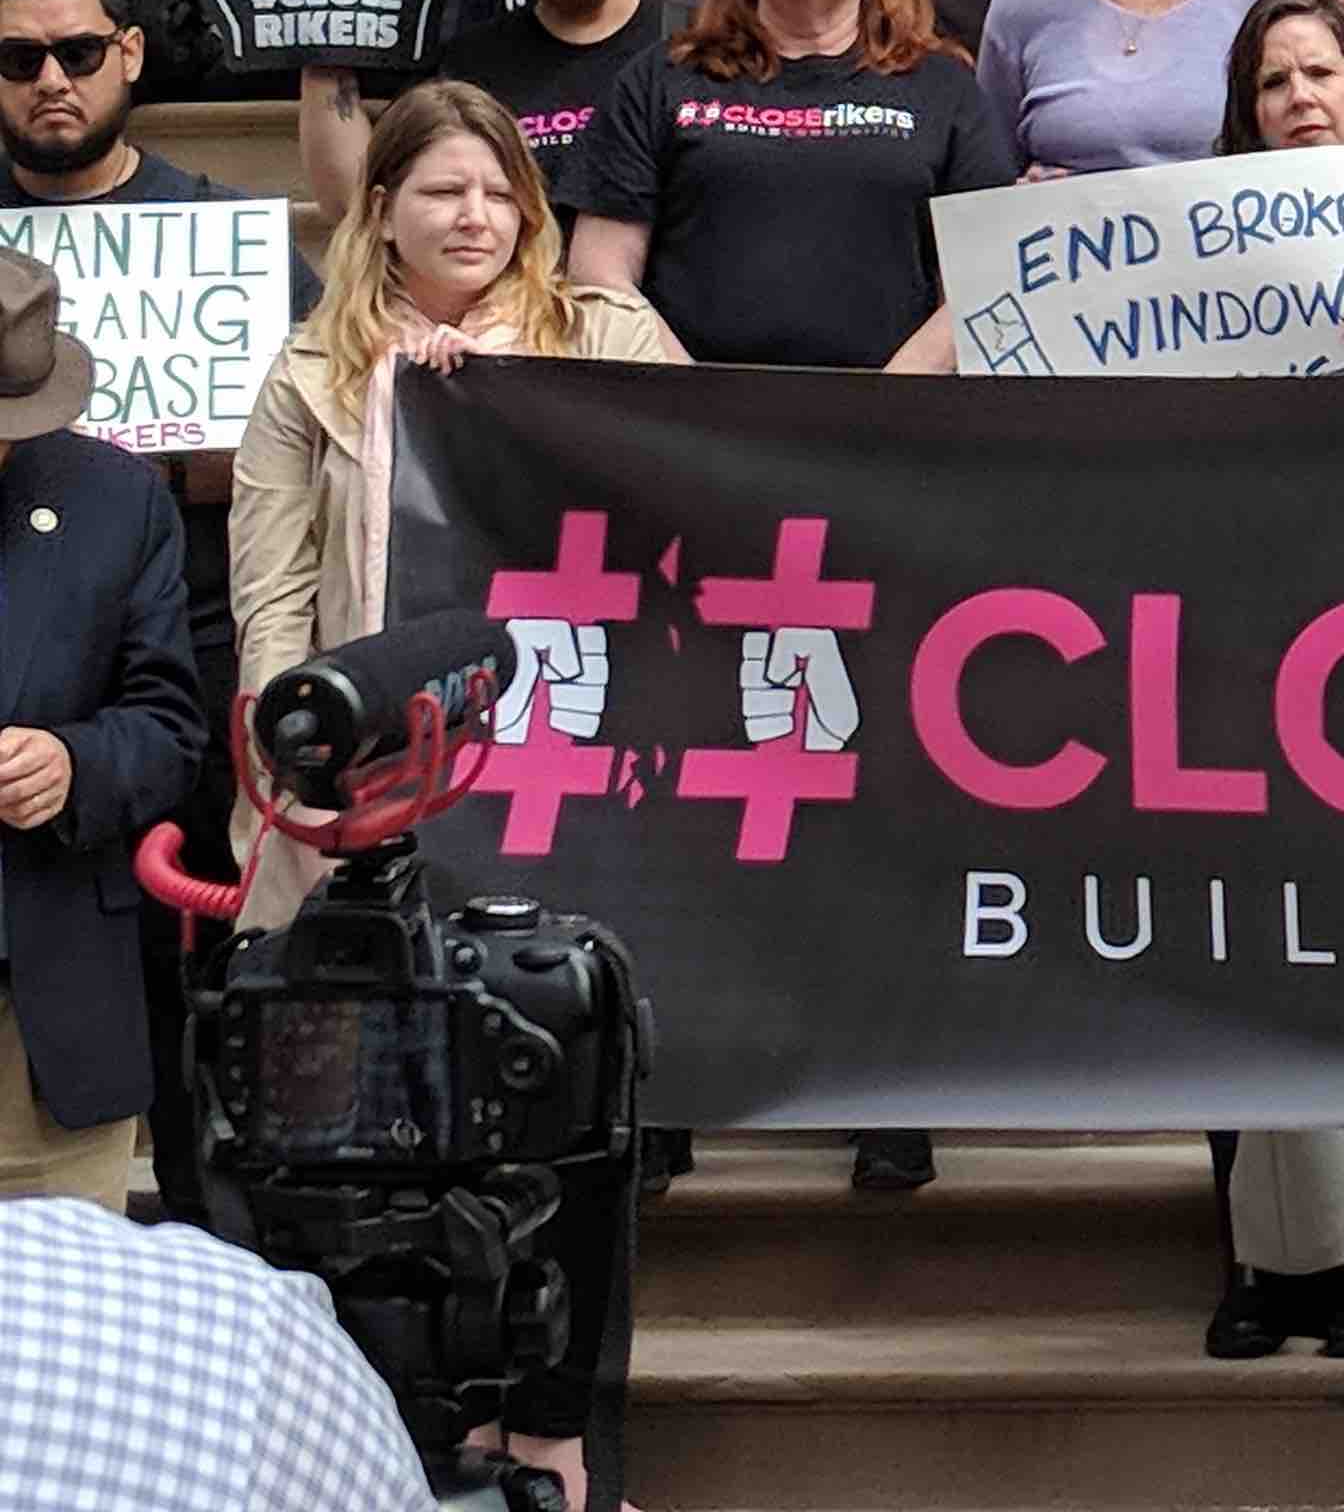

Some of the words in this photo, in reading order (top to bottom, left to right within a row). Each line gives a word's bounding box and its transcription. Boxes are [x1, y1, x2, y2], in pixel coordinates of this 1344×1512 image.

[254, 11, 400, 49] RIKERS
[1018, 213, 1161, 294] END
[87, 353, 251, 424] BASE
